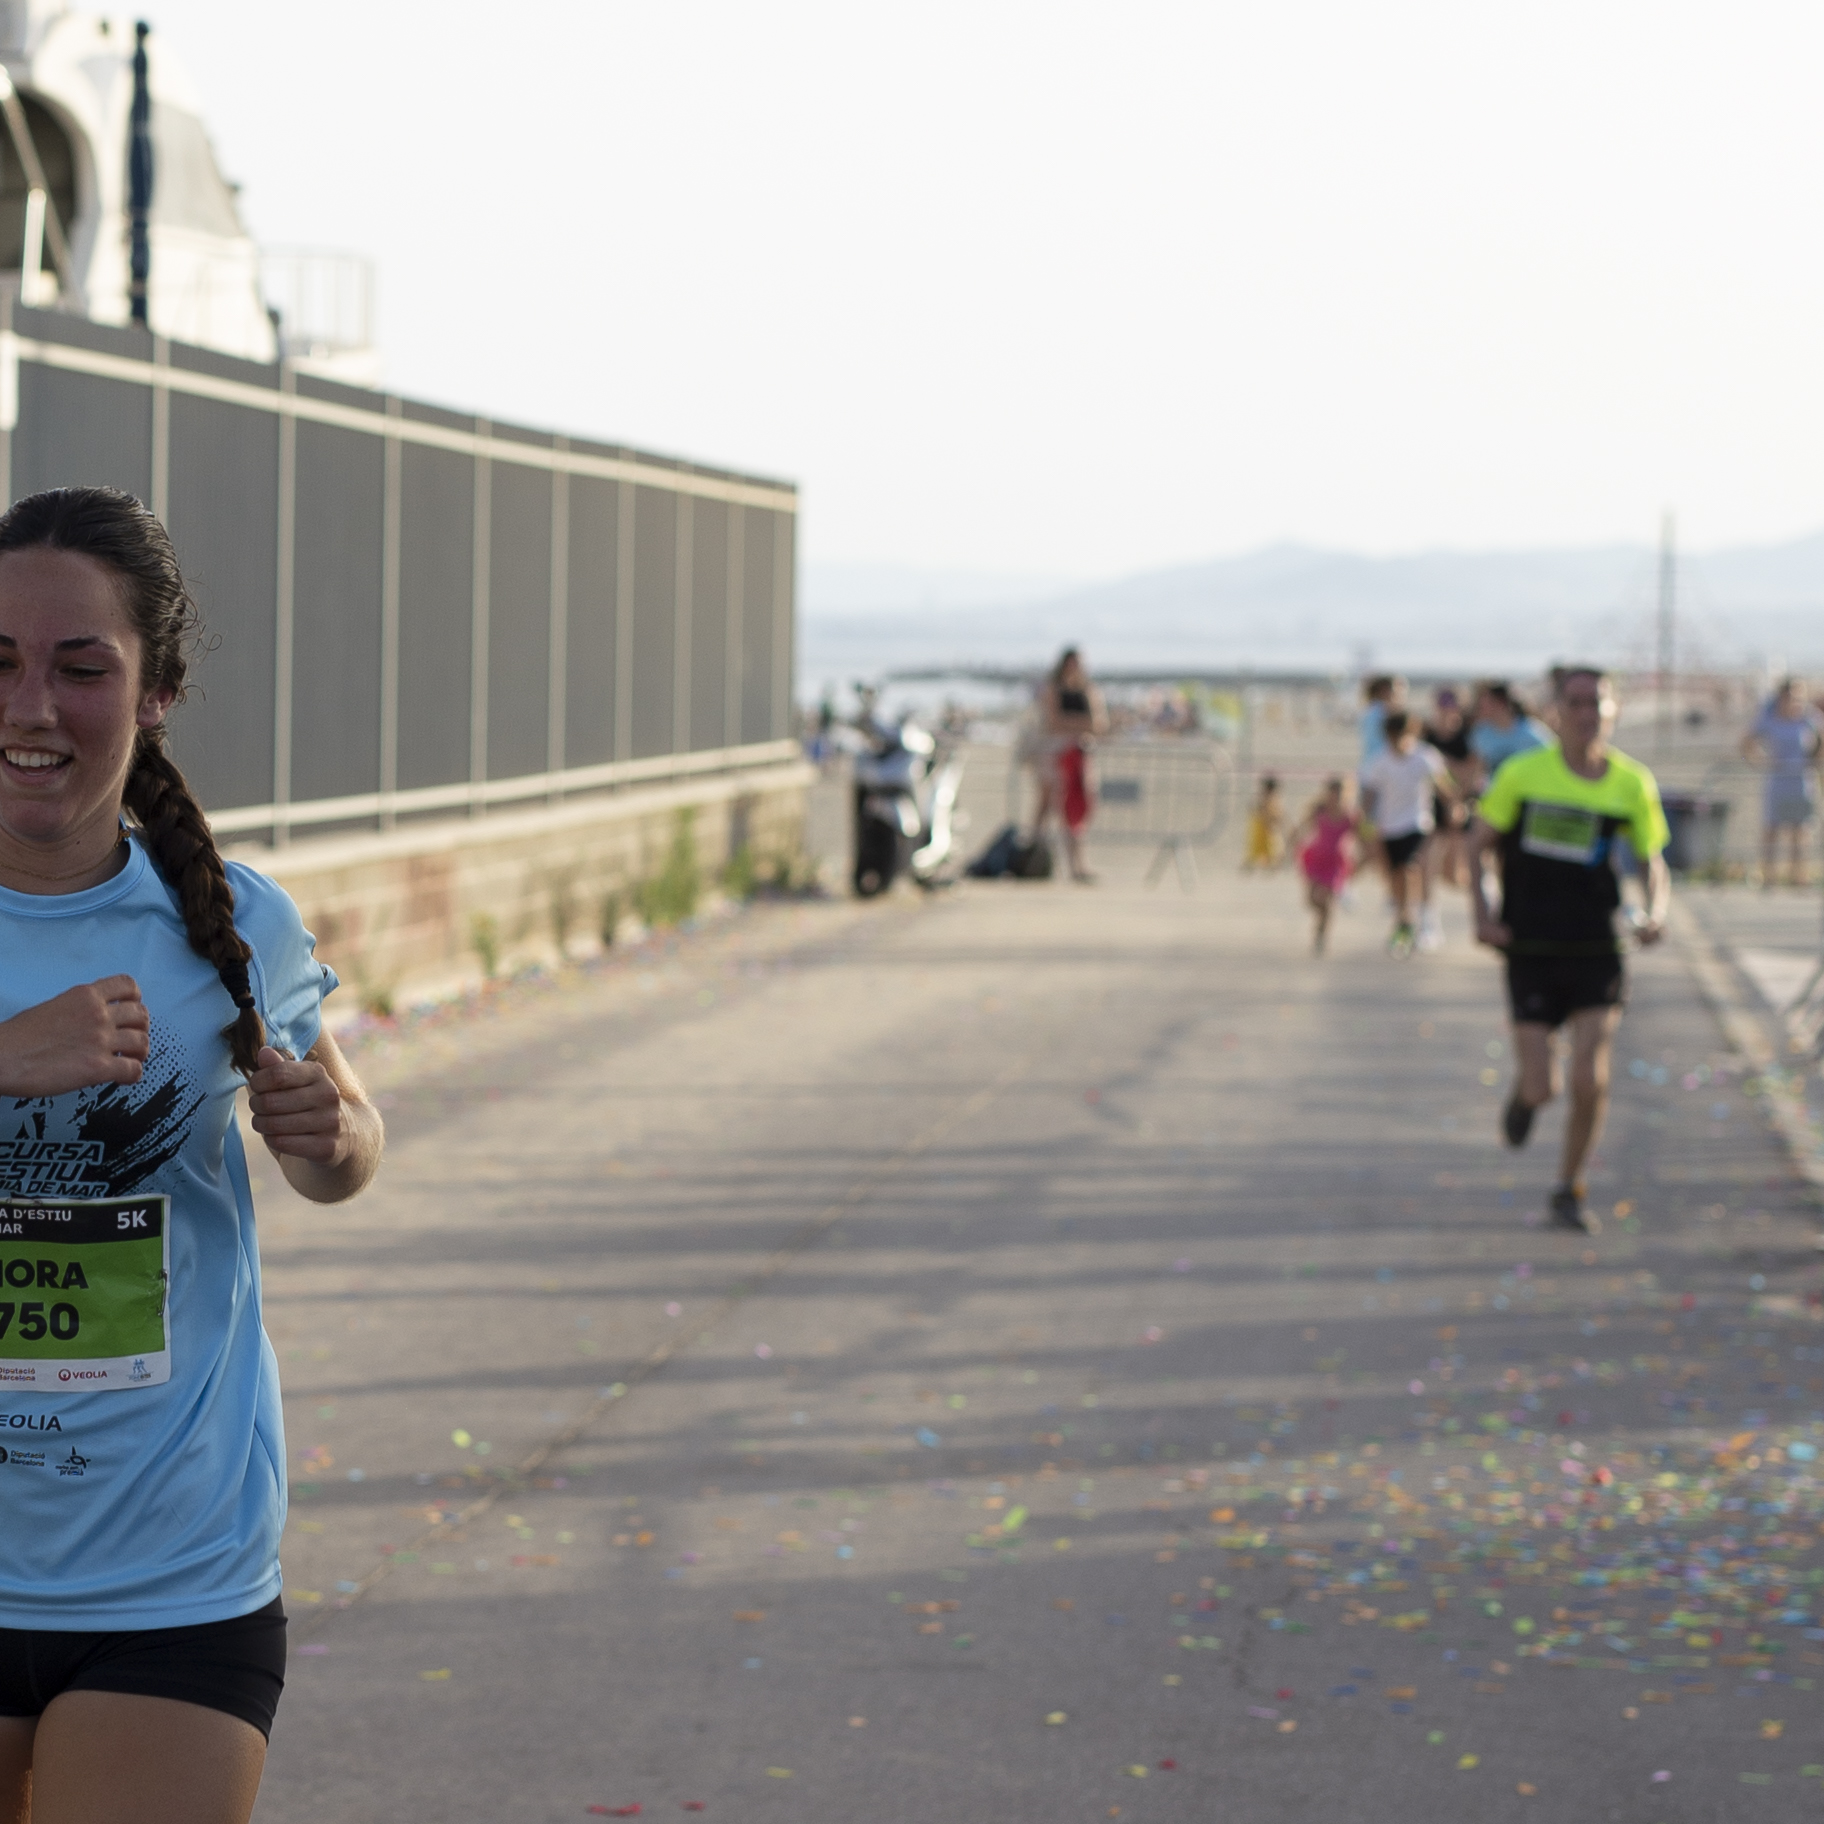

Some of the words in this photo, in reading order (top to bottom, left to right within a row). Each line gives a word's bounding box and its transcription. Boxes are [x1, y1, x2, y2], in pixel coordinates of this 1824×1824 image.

[25, 1181, 56, 1194] DE
[56, 1182, 108, 1197] MAR
[117, 1209, 148, 1230] 5K
[72, 1370, 108, 1380] VEOLIA
